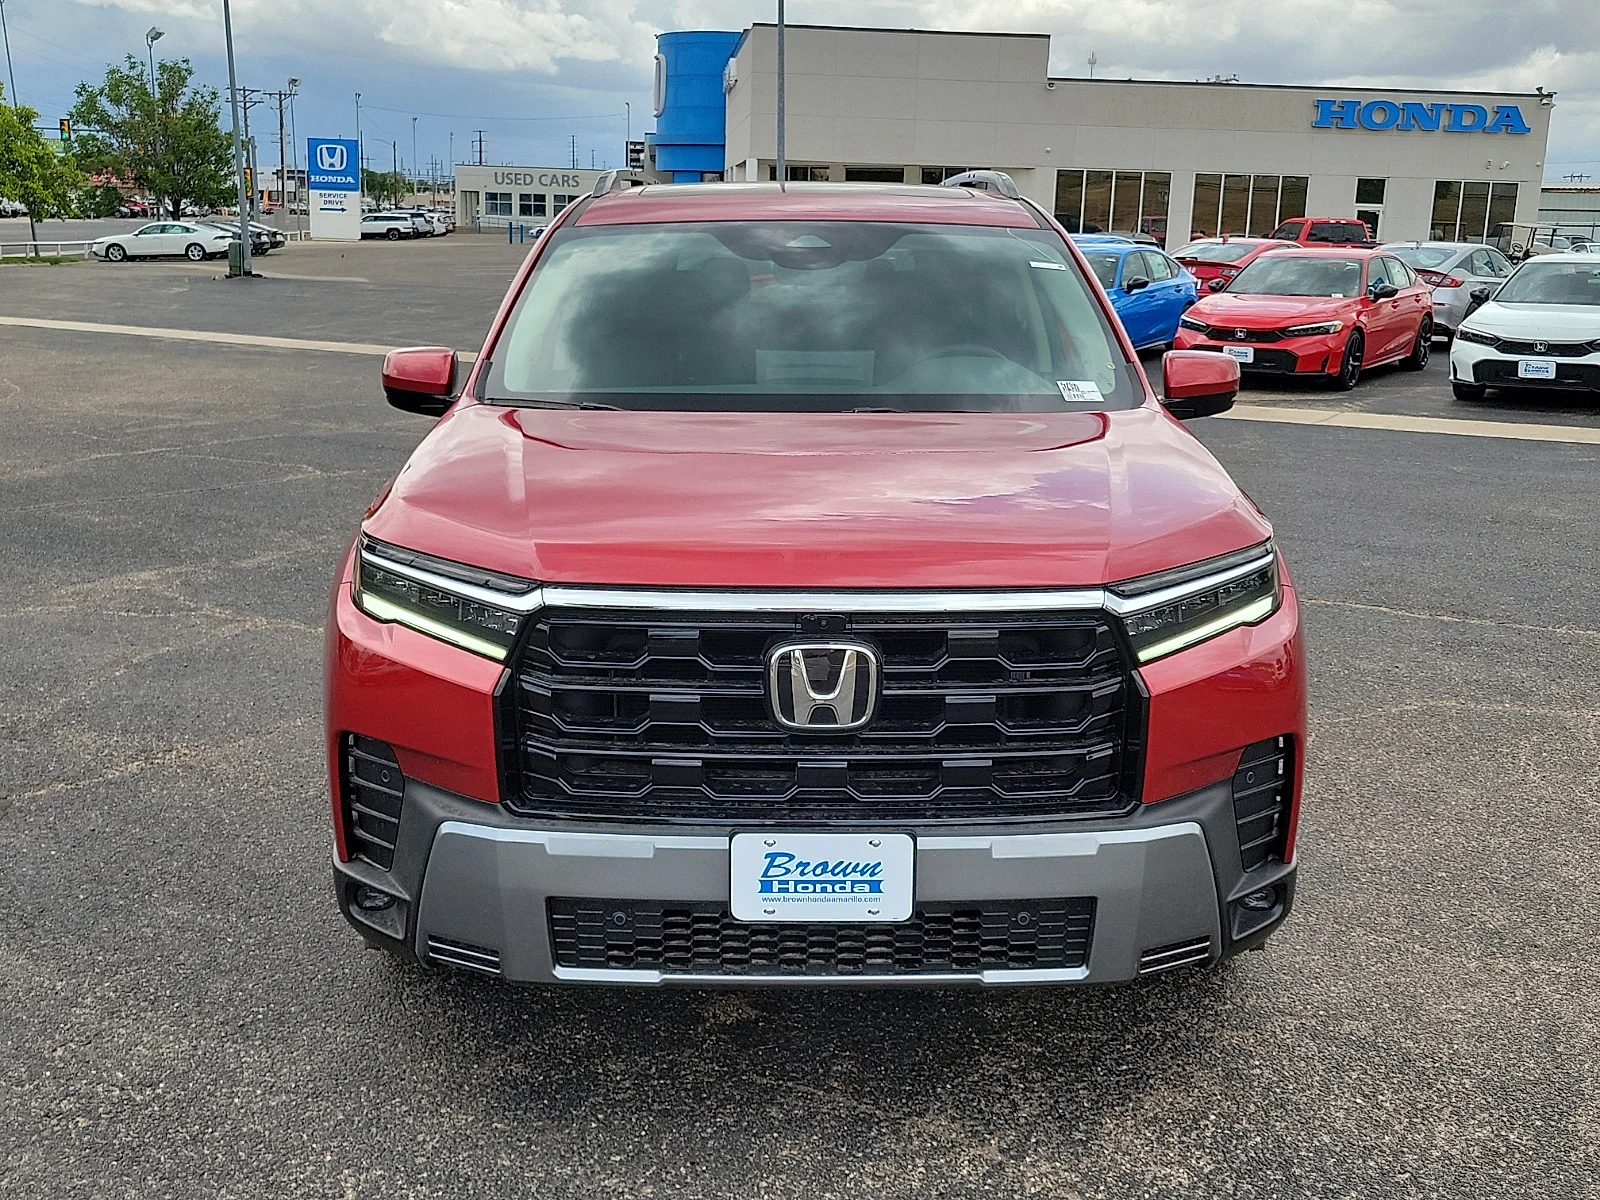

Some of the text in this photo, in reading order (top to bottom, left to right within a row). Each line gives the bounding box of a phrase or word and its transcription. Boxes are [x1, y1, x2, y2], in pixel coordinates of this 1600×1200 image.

[1312, 98, 1531, 134] HONDA
[310, 175, 355, 183] HONDA
[494, 171, 580, 188] USED CARS
[760, 851, 884, 879] Brown
[772, 880, 871, 893] Honda
[761, 895, 881, 904] www.brownhondaamarillo.com
